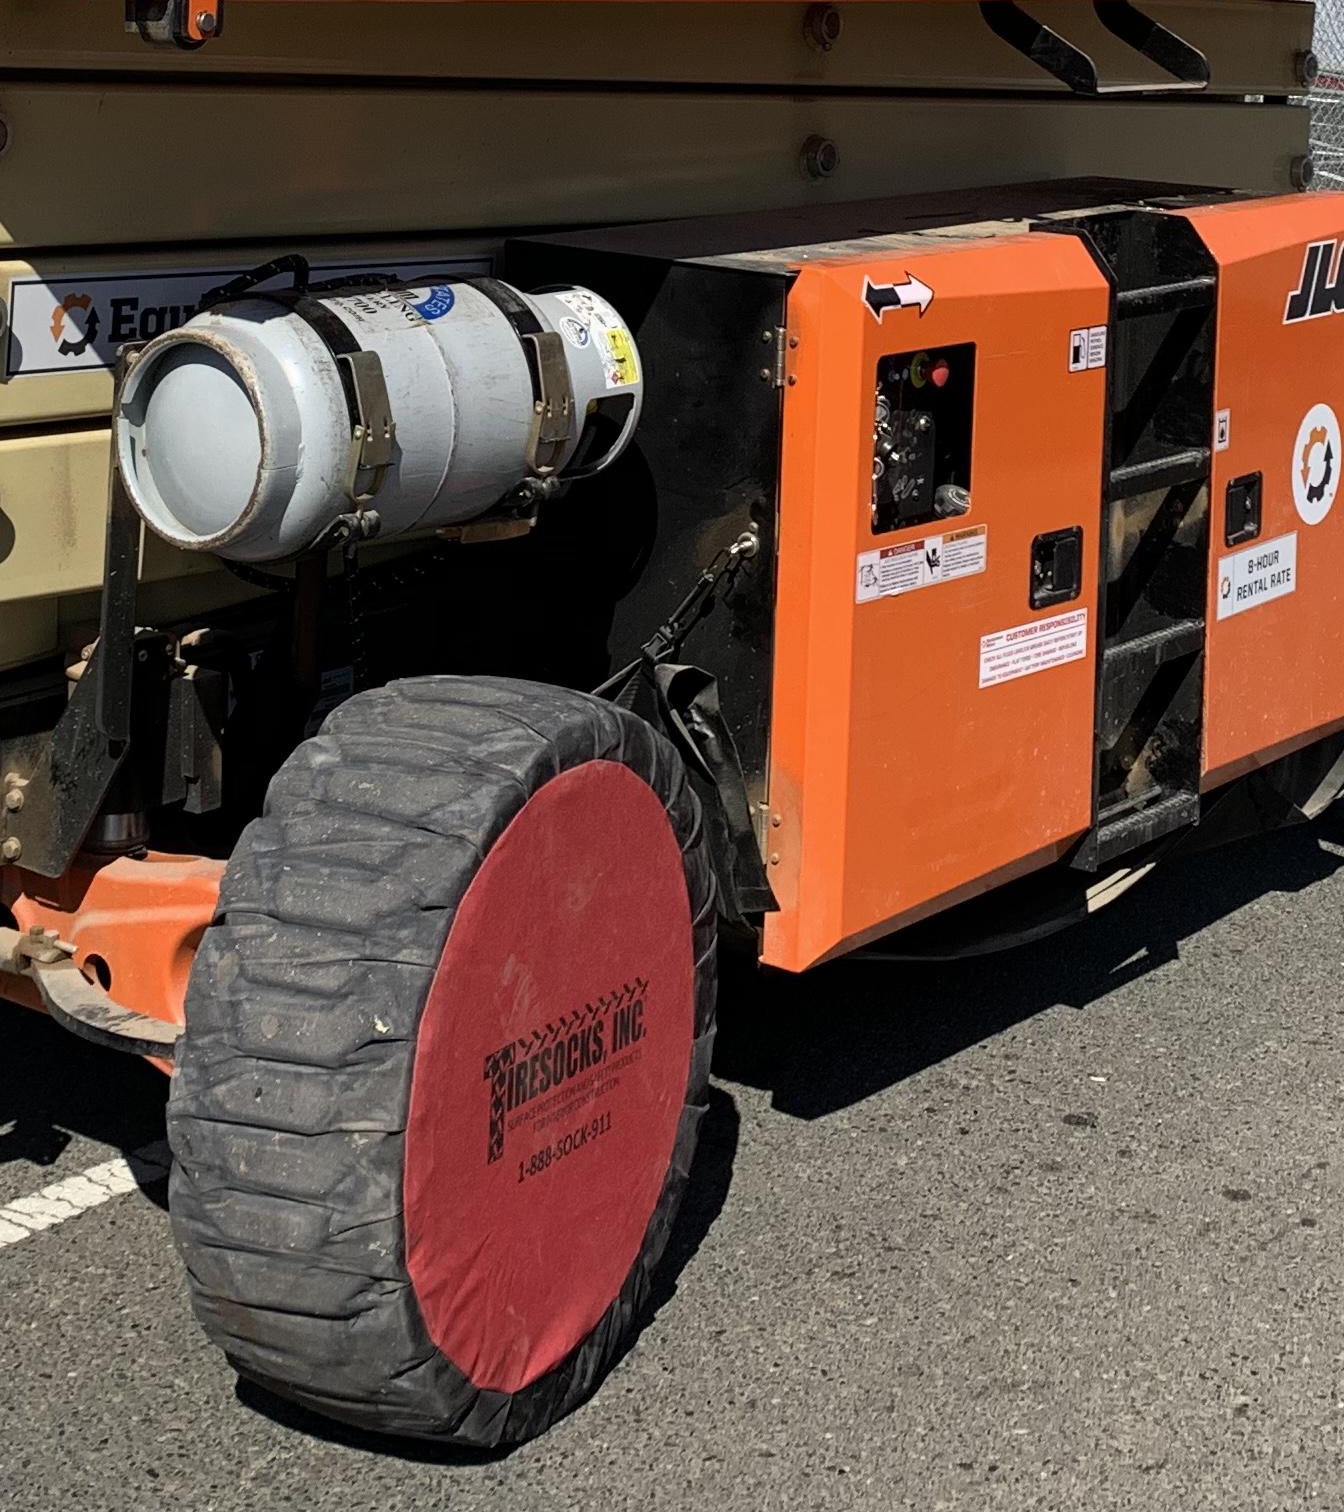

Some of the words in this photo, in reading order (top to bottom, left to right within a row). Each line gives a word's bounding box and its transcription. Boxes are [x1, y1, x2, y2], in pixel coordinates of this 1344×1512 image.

[1248, 550, 1280, 574] 8-HOUR
[1237, 577, 1268, 602] RENTAL
[1270, 568, 1292, 588] RATE
[1006, 625, 1038, 642] CUSTOMER
[1039, 613, 1086, 633] RESPONSIBILITY
[612, 999, 647, 1055] INC.
[518, 1111, 613, 1184] 1-888-SOCK-911
